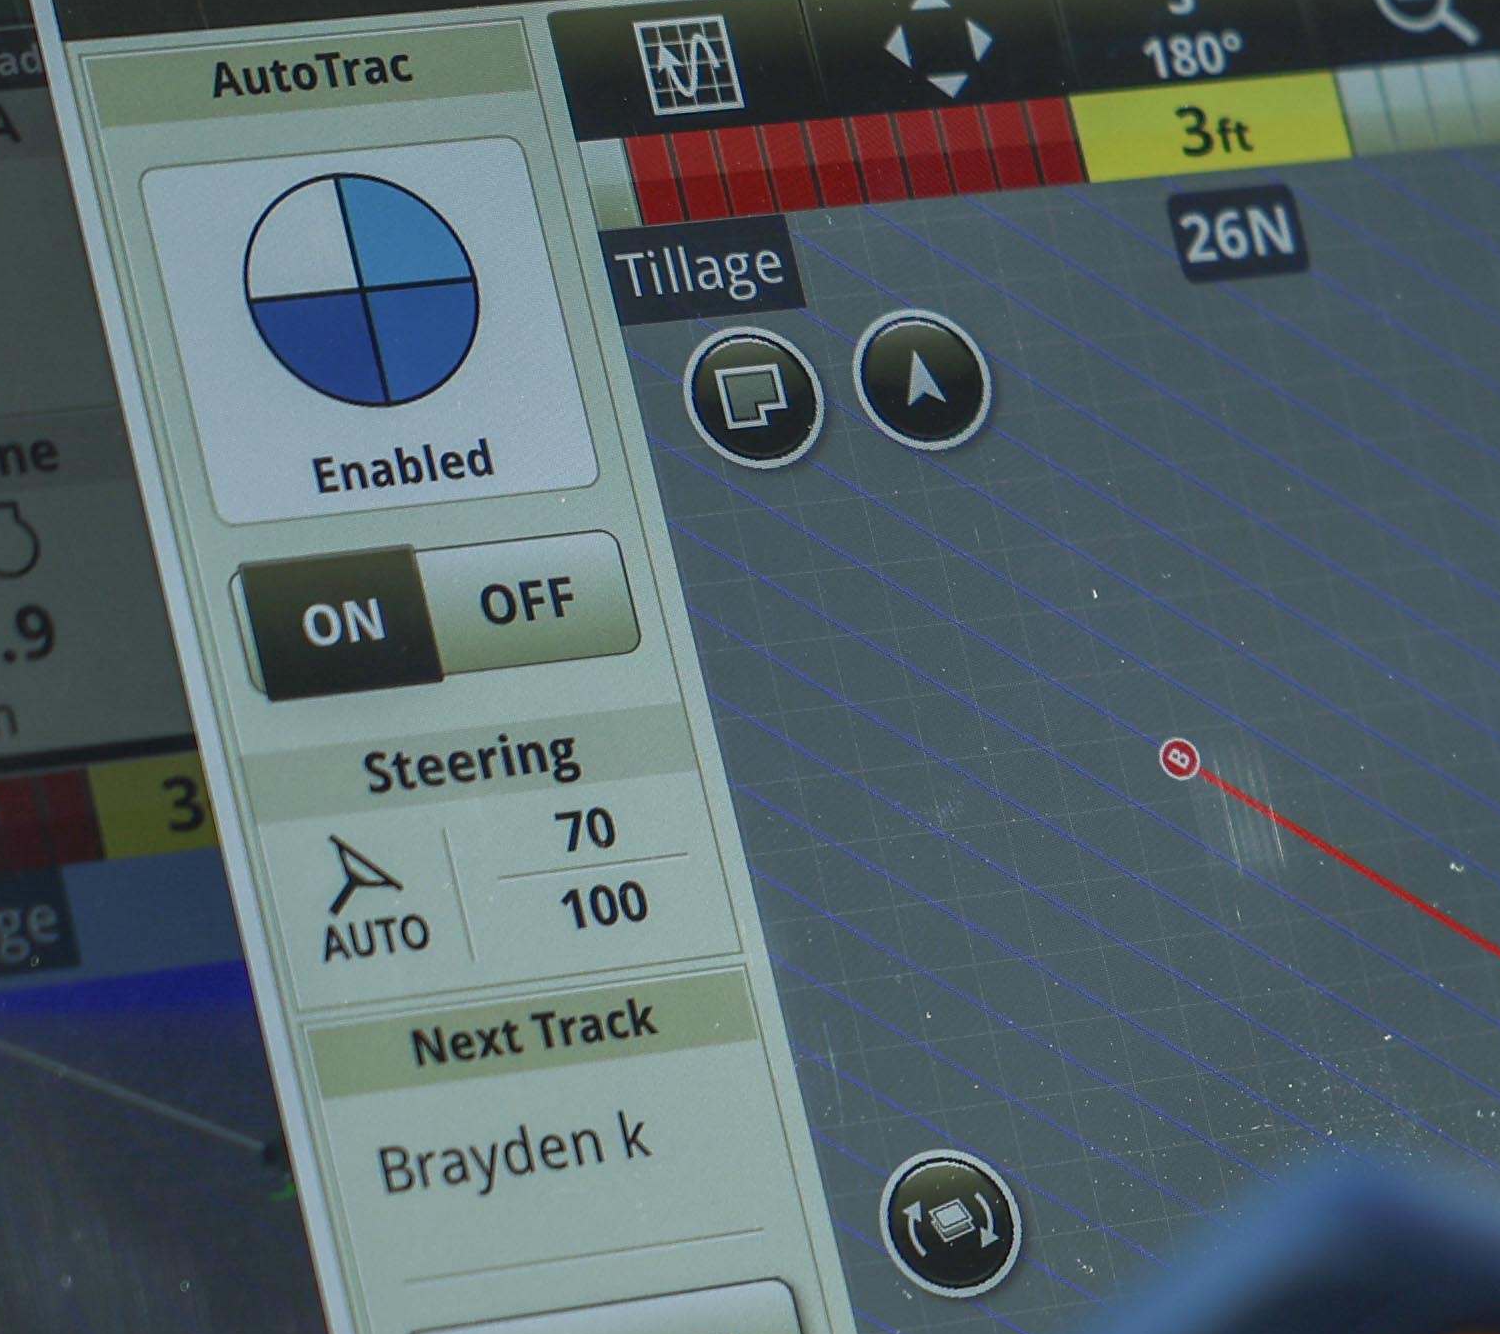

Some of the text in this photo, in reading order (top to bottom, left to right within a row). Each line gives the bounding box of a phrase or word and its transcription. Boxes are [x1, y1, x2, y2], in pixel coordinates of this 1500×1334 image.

[212, 49, 413, 99] AutoTrac
[1175, 105, 1254, 157] 3ft
[1179, 202, 1296, 264] 26N
[614, 241, 786, 302] Tillage
[311, 438, 495, 494] Enabled
[302, 597, 387, 648] ON
[480, 576, 575, 626] OFF
[363, 734, 582, 795] Steering
[554, 807, 616, 853] 70
[561, 879, 648, 930] 100
[323, 913, 431, 963] AUTO
[411, 997, 659, 1069] Next Track
[378, 1109, 653, 1196] Brayden k
